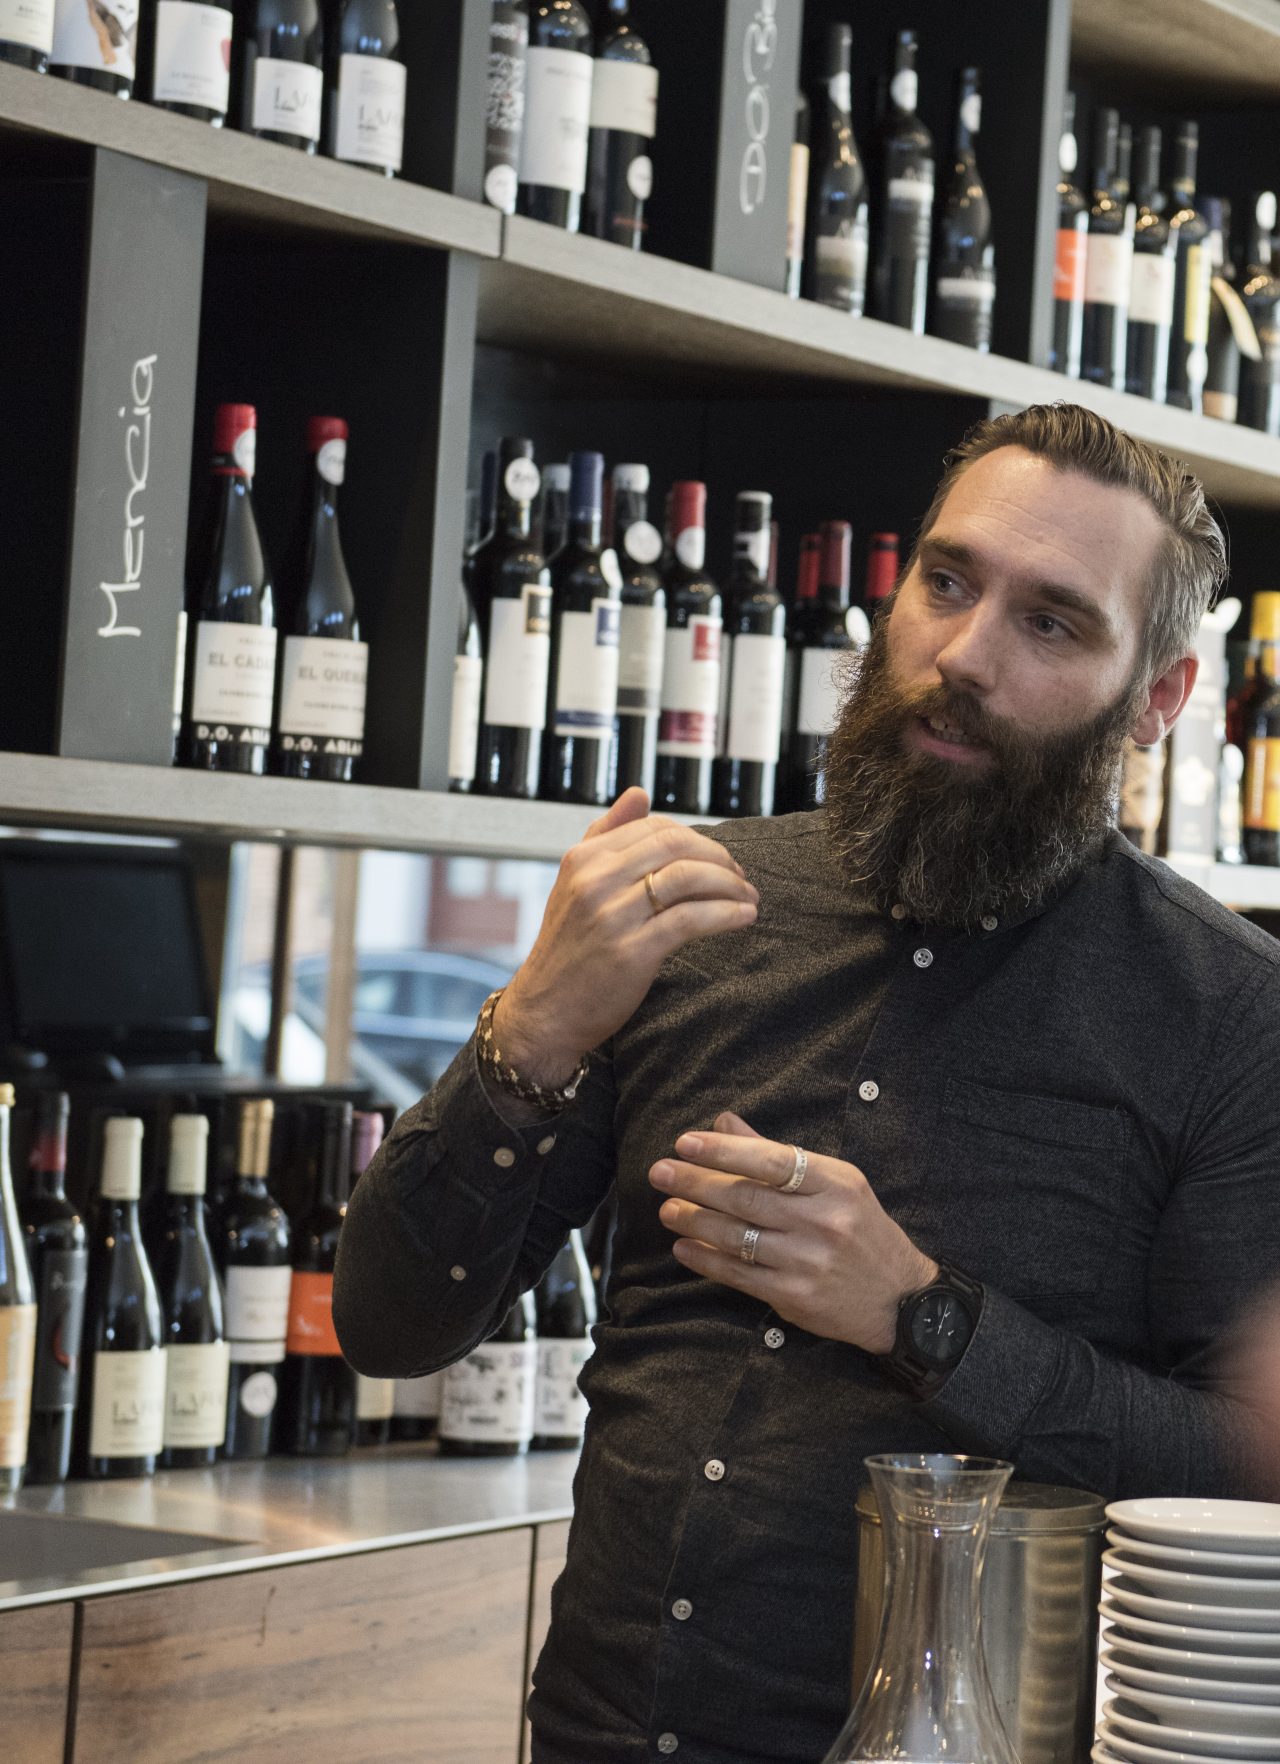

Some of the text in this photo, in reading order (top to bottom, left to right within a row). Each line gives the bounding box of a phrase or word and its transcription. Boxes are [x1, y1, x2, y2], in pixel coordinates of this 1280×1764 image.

[97, 353, 159, 638] Mencia
[208, 651, 229, 667] EL
[298, 665, 318, 681] EL
[197, 724, 234, 742] D.O.
[282, 736, 318, 753] D.O.
